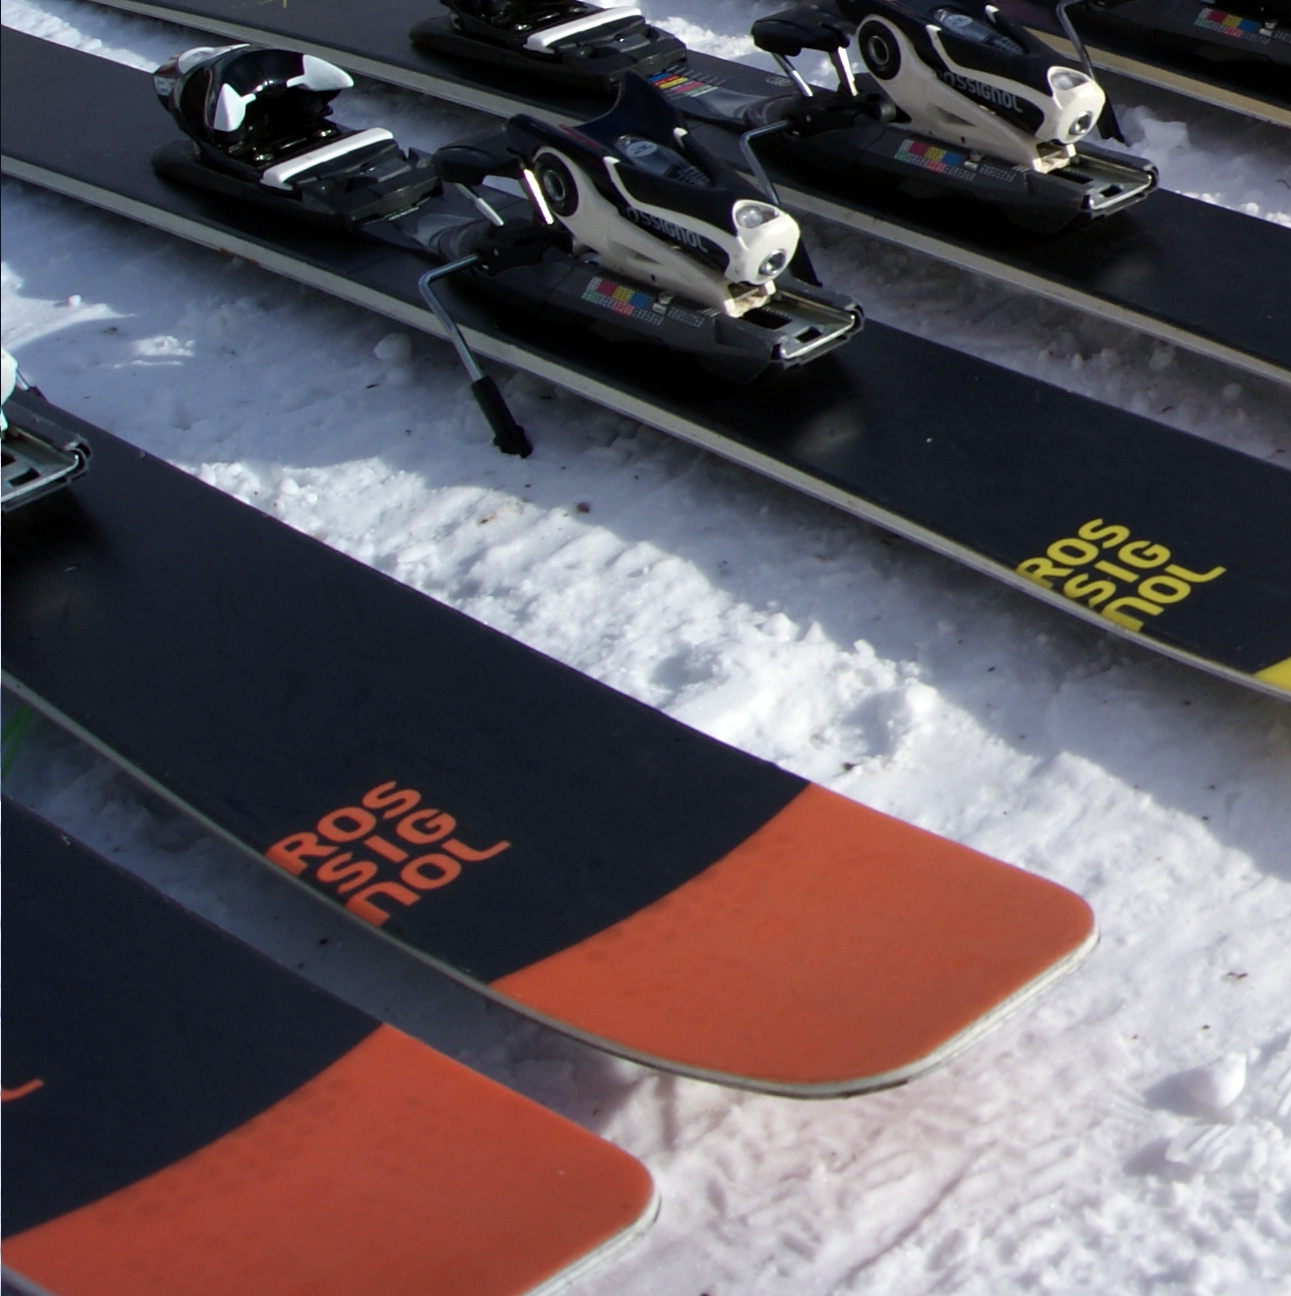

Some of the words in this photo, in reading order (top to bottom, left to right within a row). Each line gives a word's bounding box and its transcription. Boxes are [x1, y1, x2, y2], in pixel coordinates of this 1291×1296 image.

[1015, 518, 1131, 589] ROS
[1063, 540, 1172, 608] SIG
[264, 780, 422, 876] ROS
[316, 808, 457, 895] SIG
